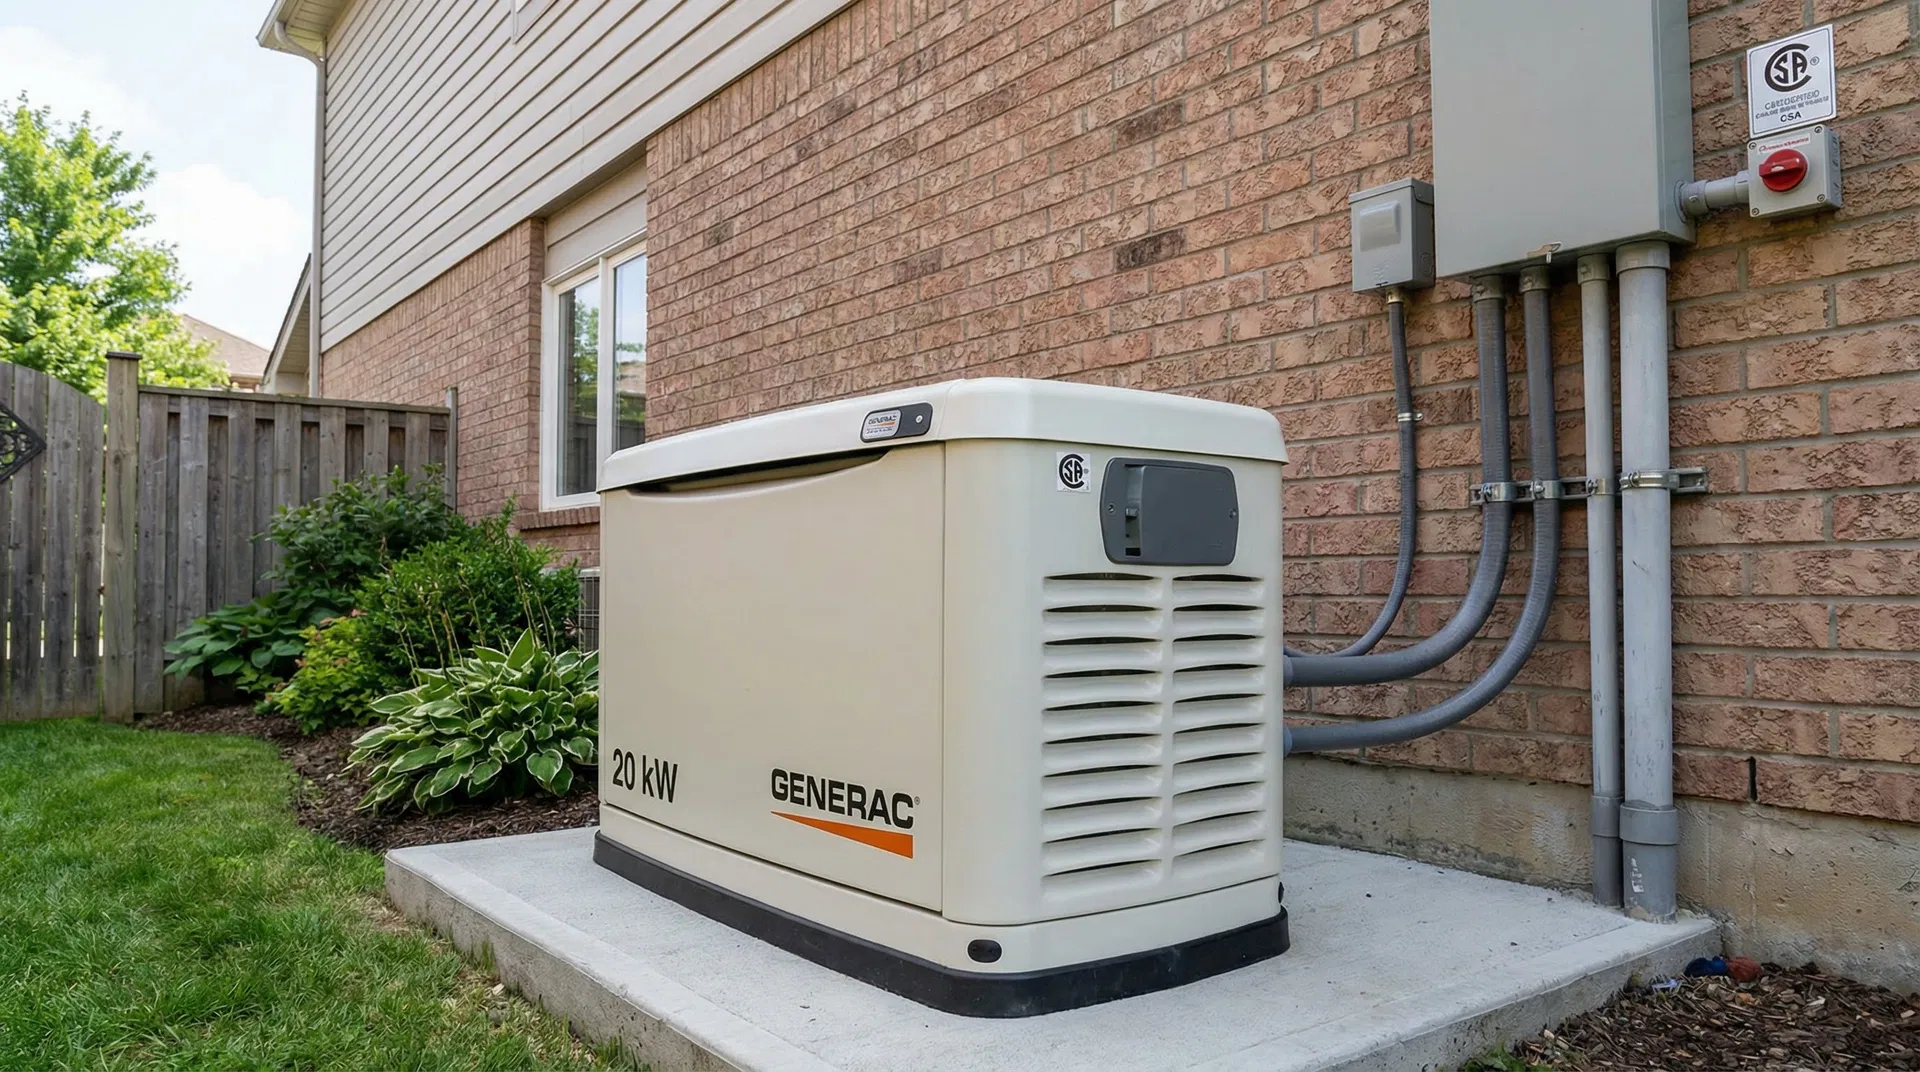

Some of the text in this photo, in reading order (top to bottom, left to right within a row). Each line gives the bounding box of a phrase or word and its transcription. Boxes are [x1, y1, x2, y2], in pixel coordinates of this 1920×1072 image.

[1780, 111, 1802, 122] CSA
[612, 748, 678, 803] 20 kW
[771, 768, 914, 829] GENERAC
